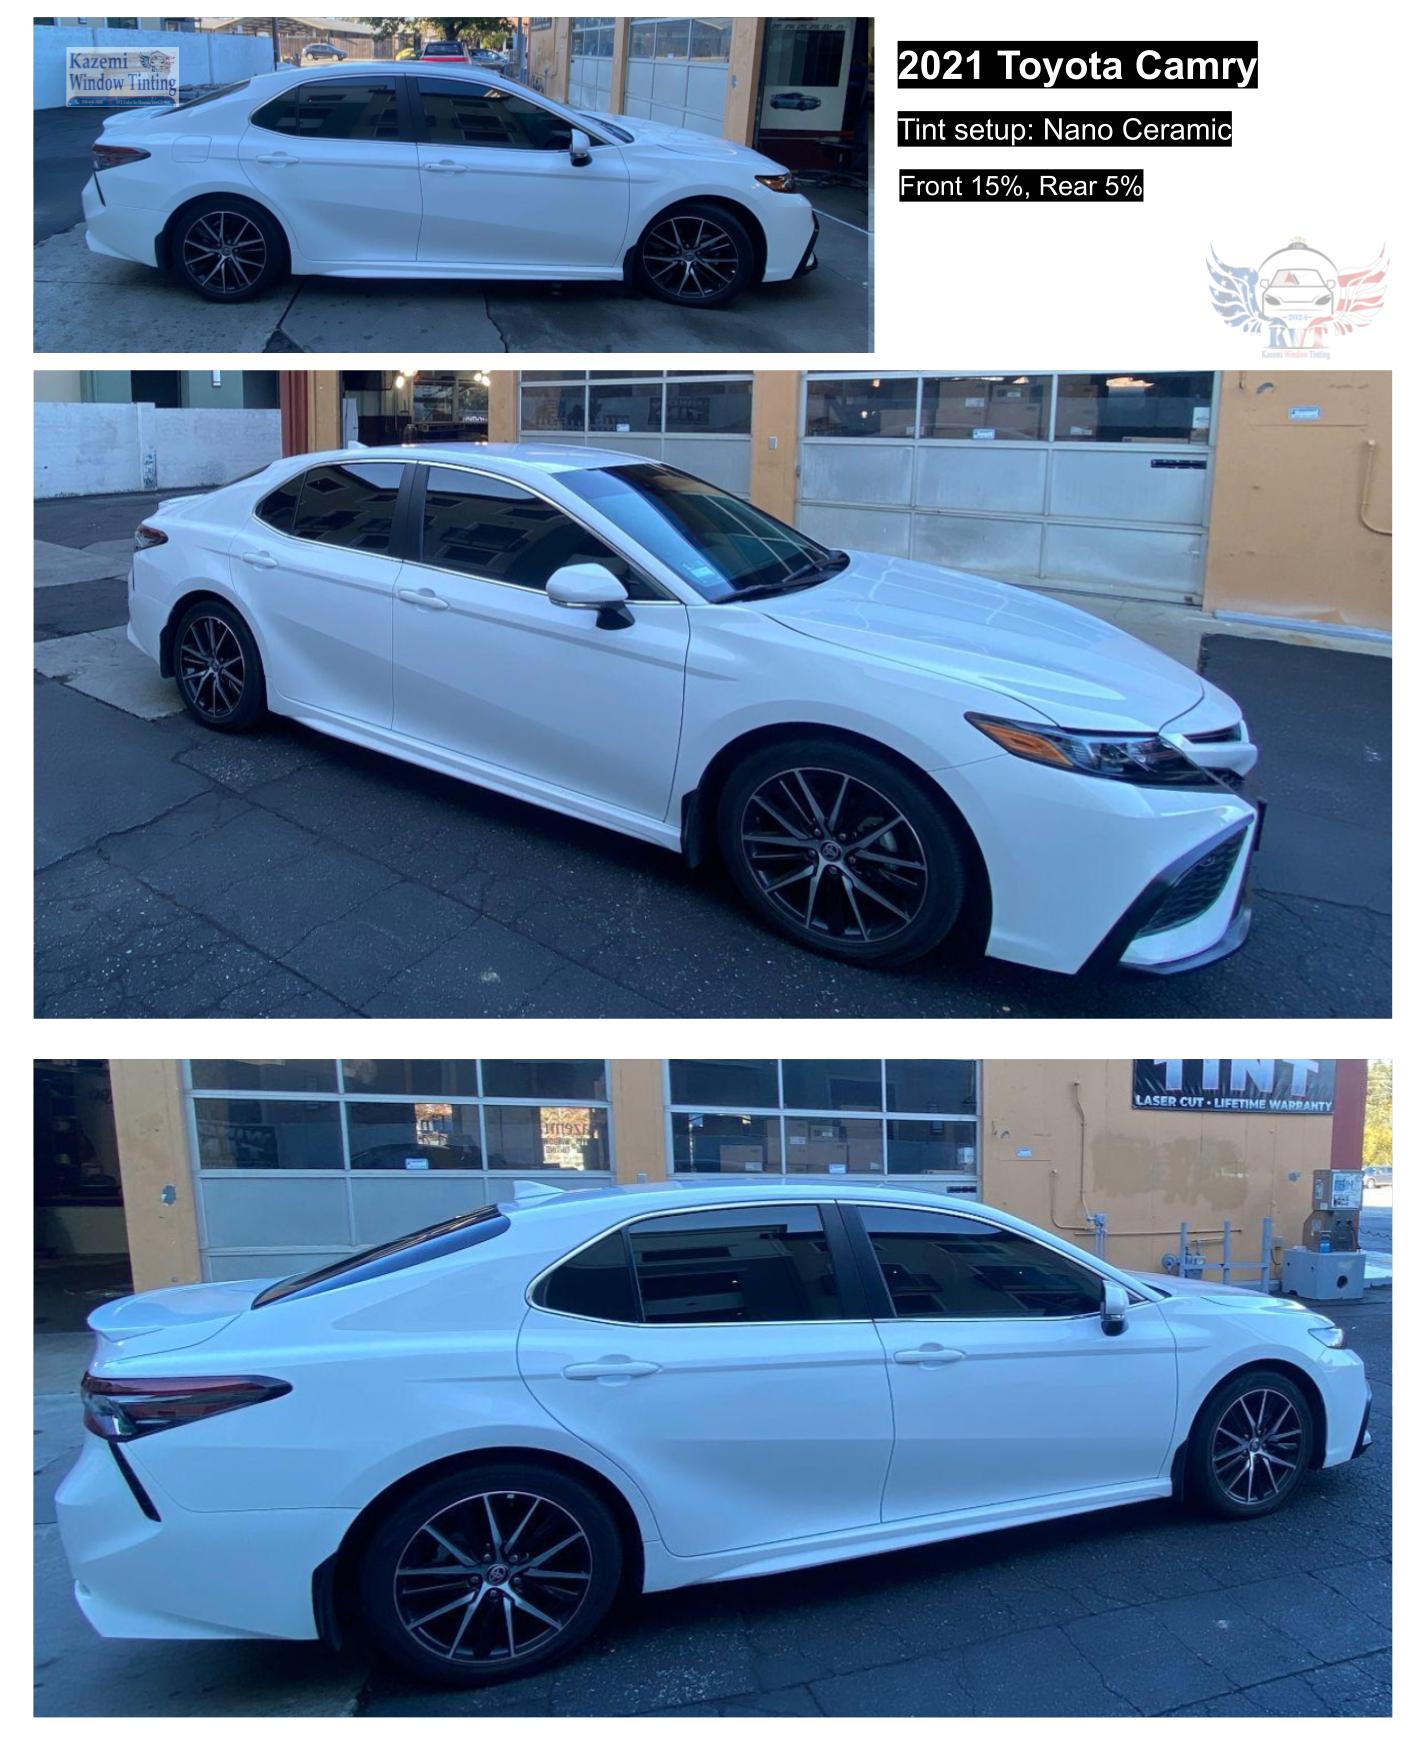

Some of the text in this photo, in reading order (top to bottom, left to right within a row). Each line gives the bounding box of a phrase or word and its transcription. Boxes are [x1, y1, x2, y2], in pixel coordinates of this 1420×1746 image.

[1135, 1095, 1333, 1112] LASER CUT LIFETIME WARRANTY
